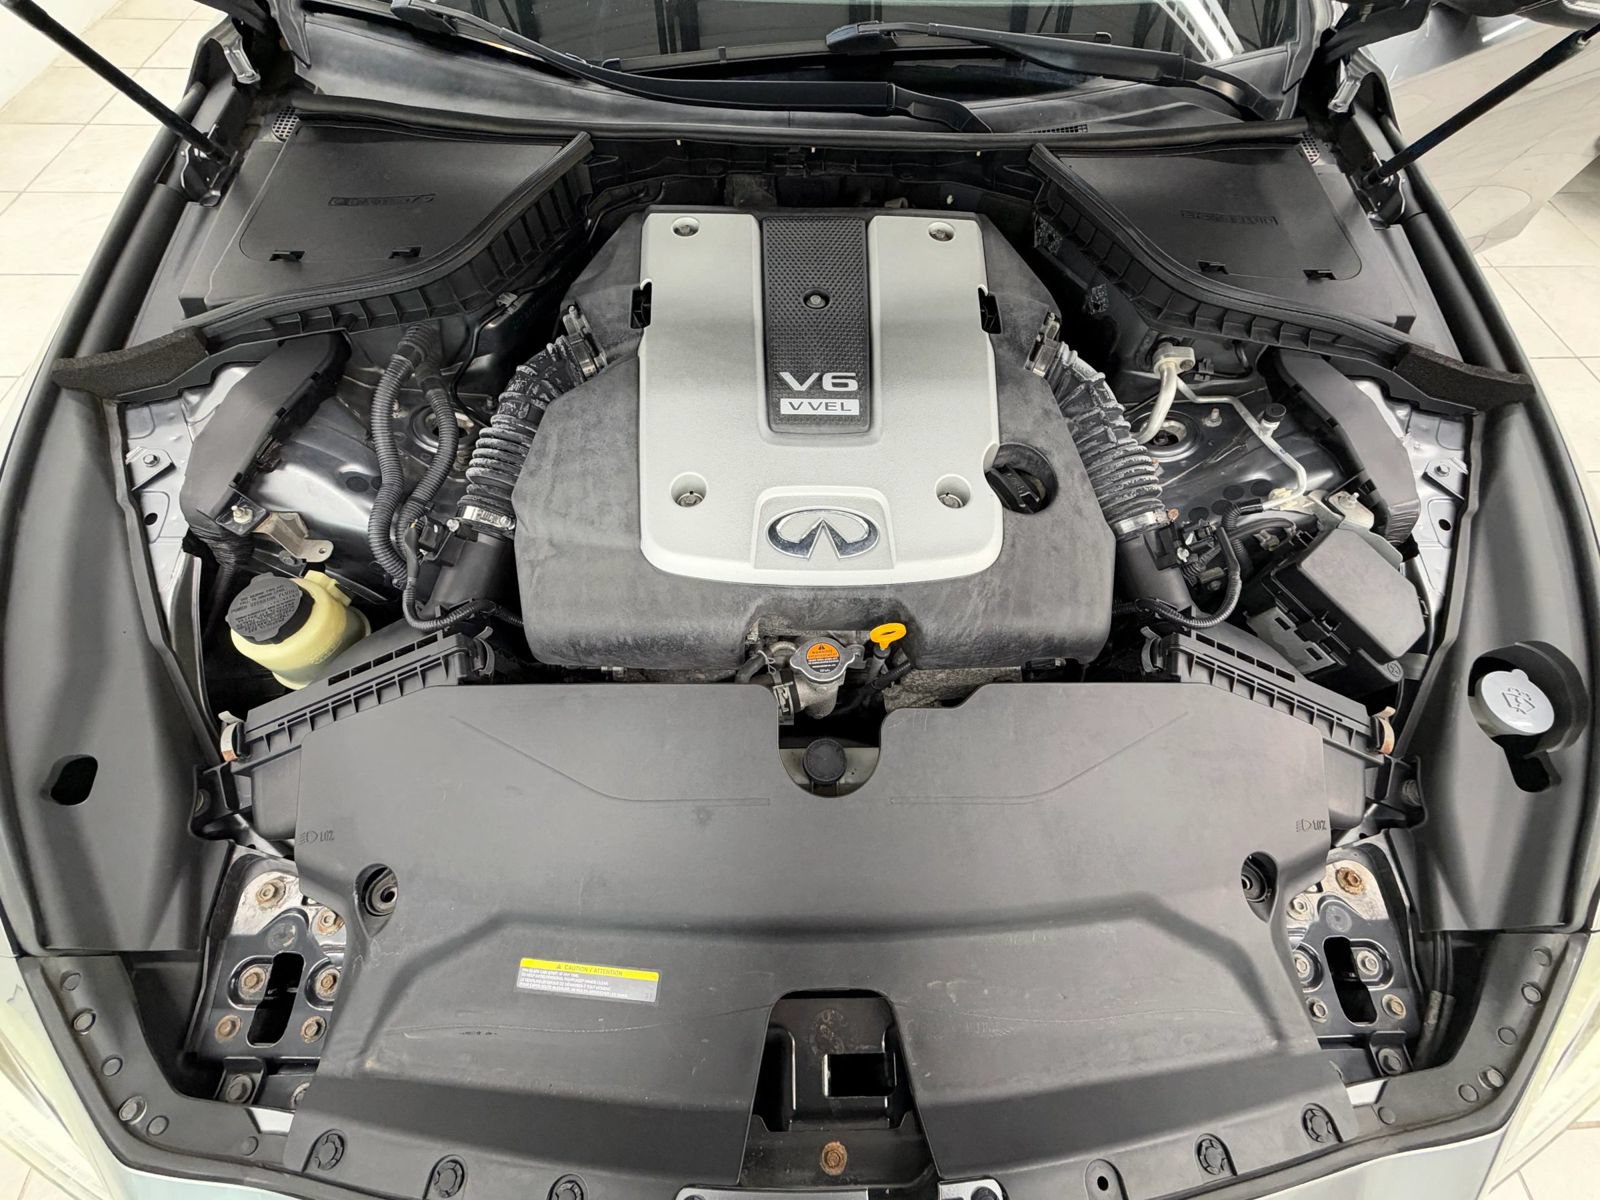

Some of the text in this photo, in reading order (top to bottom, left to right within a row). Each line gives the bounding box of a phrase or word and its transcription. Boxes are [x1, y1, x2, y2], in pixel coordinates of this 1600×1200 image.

[780, 372, 858, 391] V6
[788, 401, 852, 412] VVEL
[564, 964, 589, 972] CAUTION
